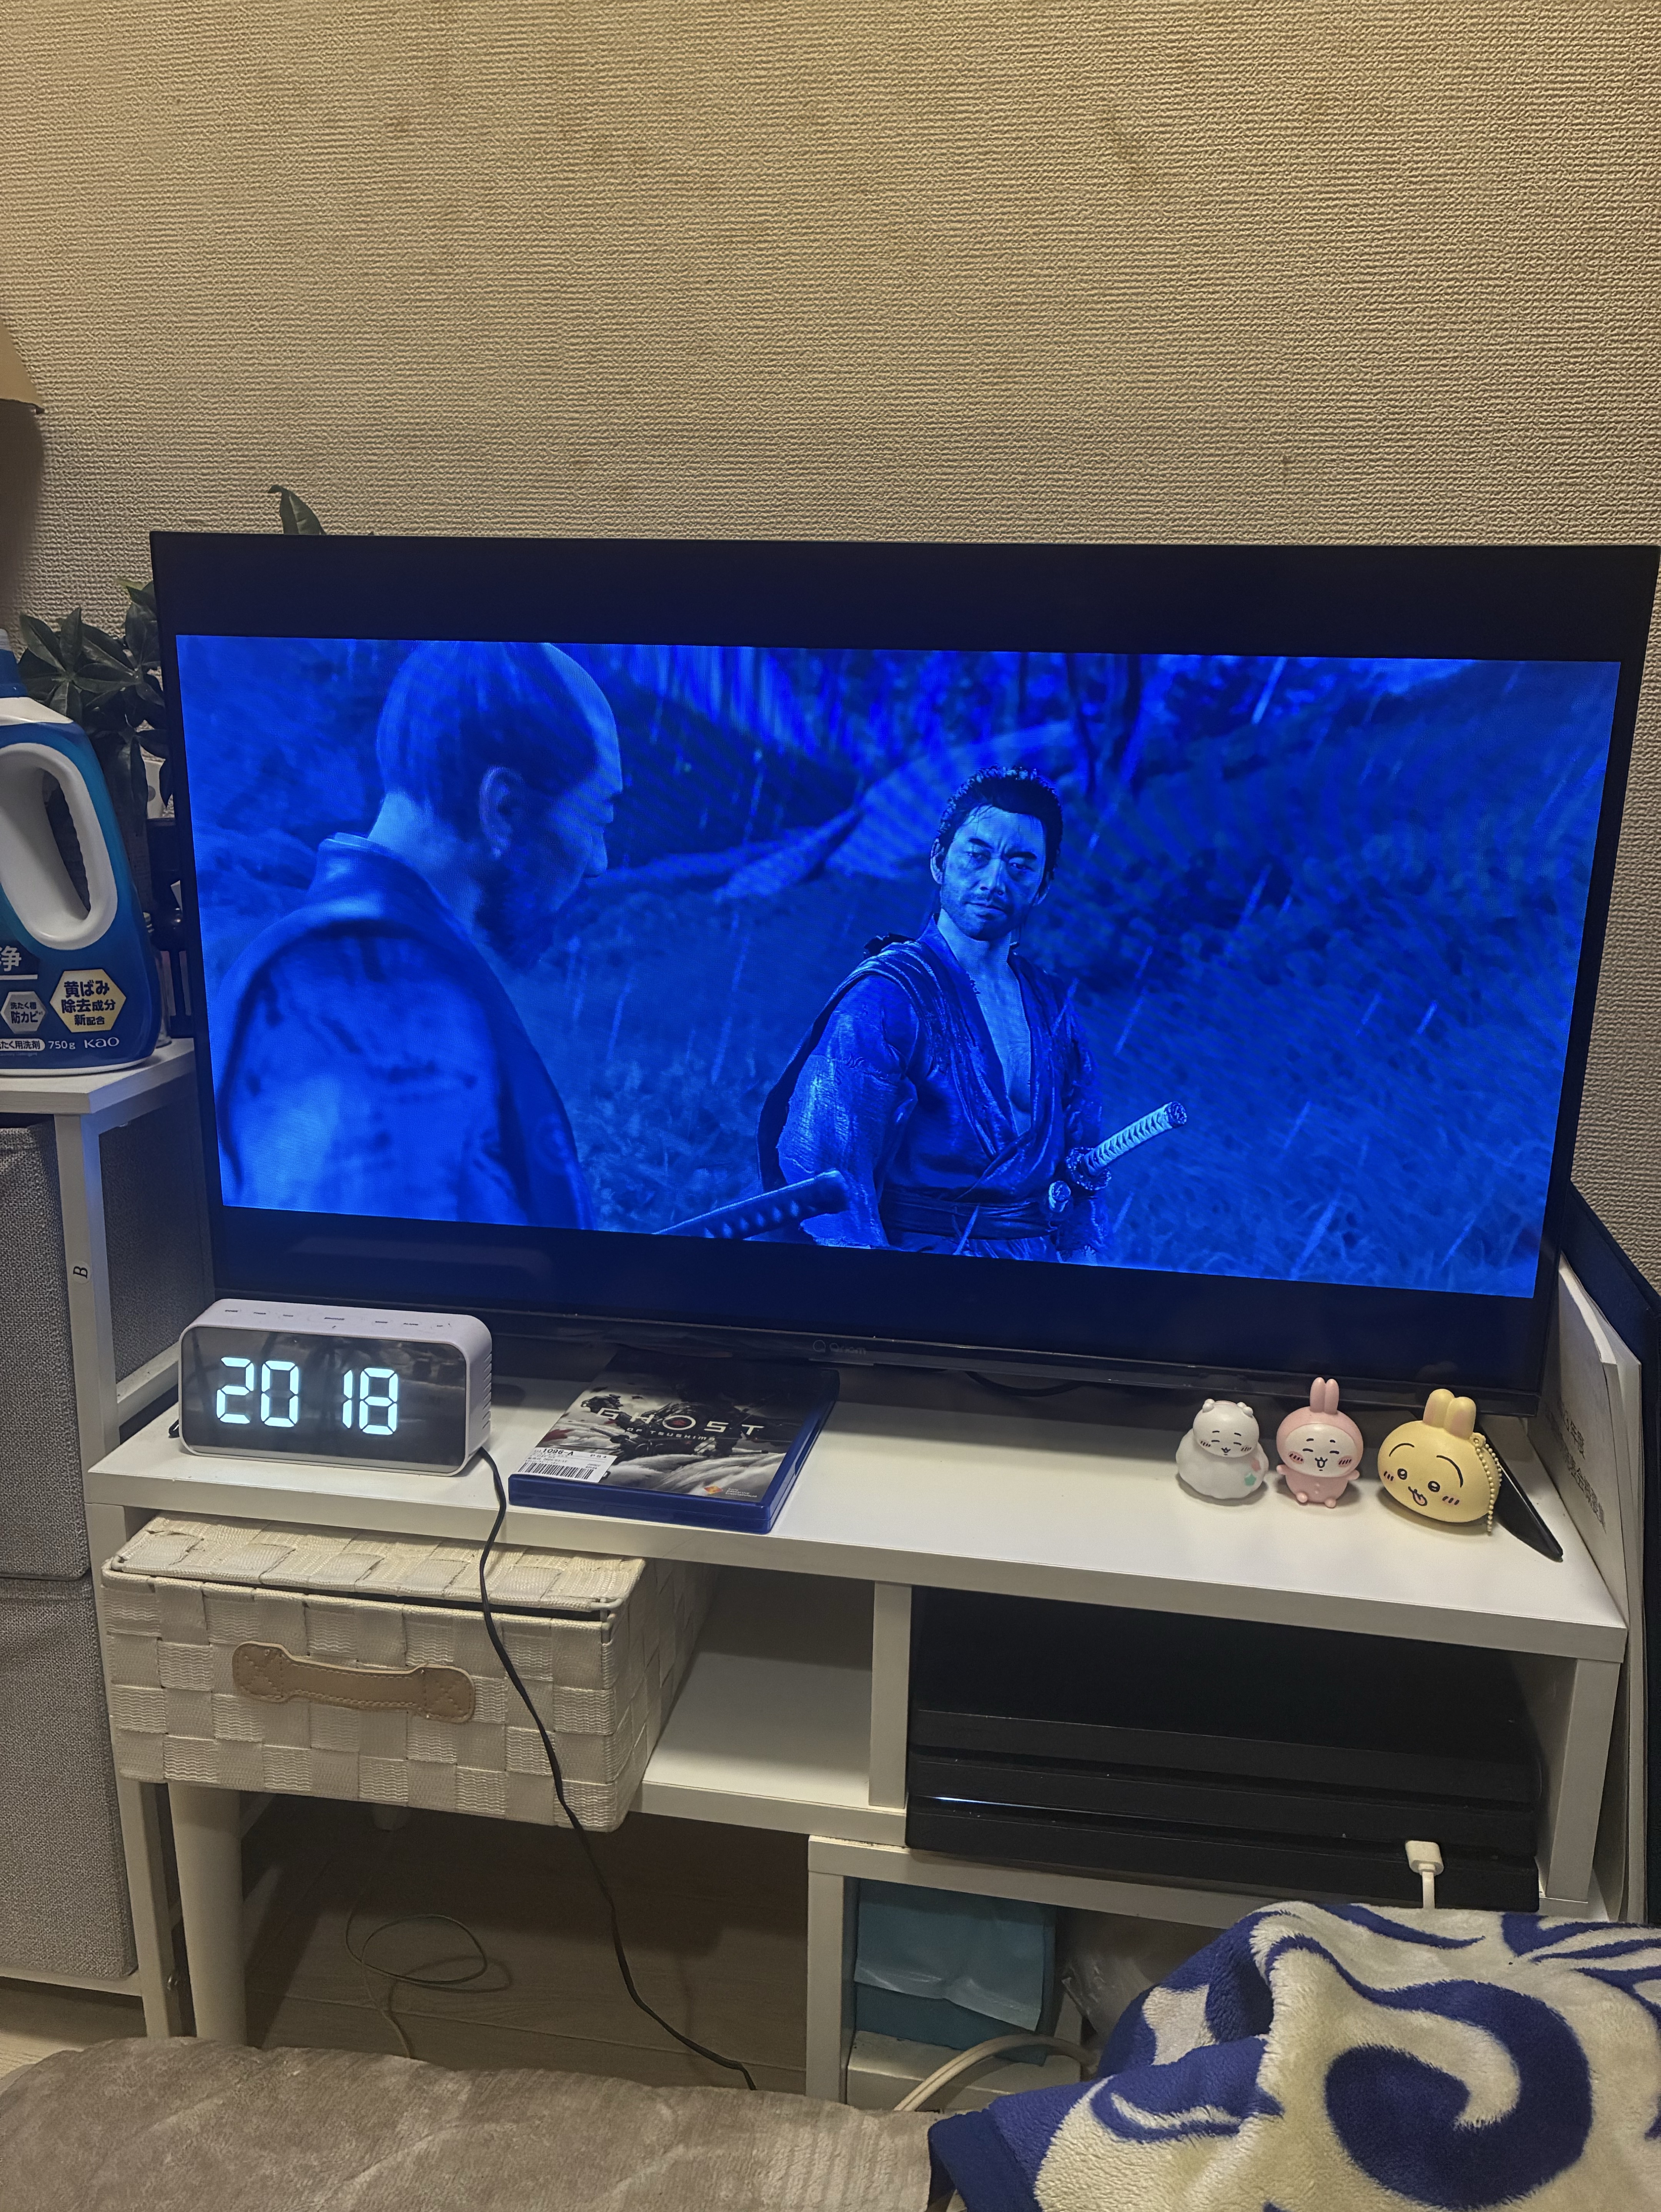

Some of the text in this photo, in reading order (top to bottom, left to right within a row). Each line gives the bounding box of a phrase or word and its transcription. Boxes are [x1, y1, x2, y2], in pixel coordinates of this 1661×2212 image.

[64, 980, 110, 998] 黄ばみ
[61, 999, 116, 1013] 除去成分
[74, 1014, 105, 1026] 新配合
[0, 1040, 40, 1049] たく用洗剤
[73, 1266, 88, 1279] B
[216, 1357, 398, 1435] 20 18
[597, 1407, 765, 1435] GHOST
